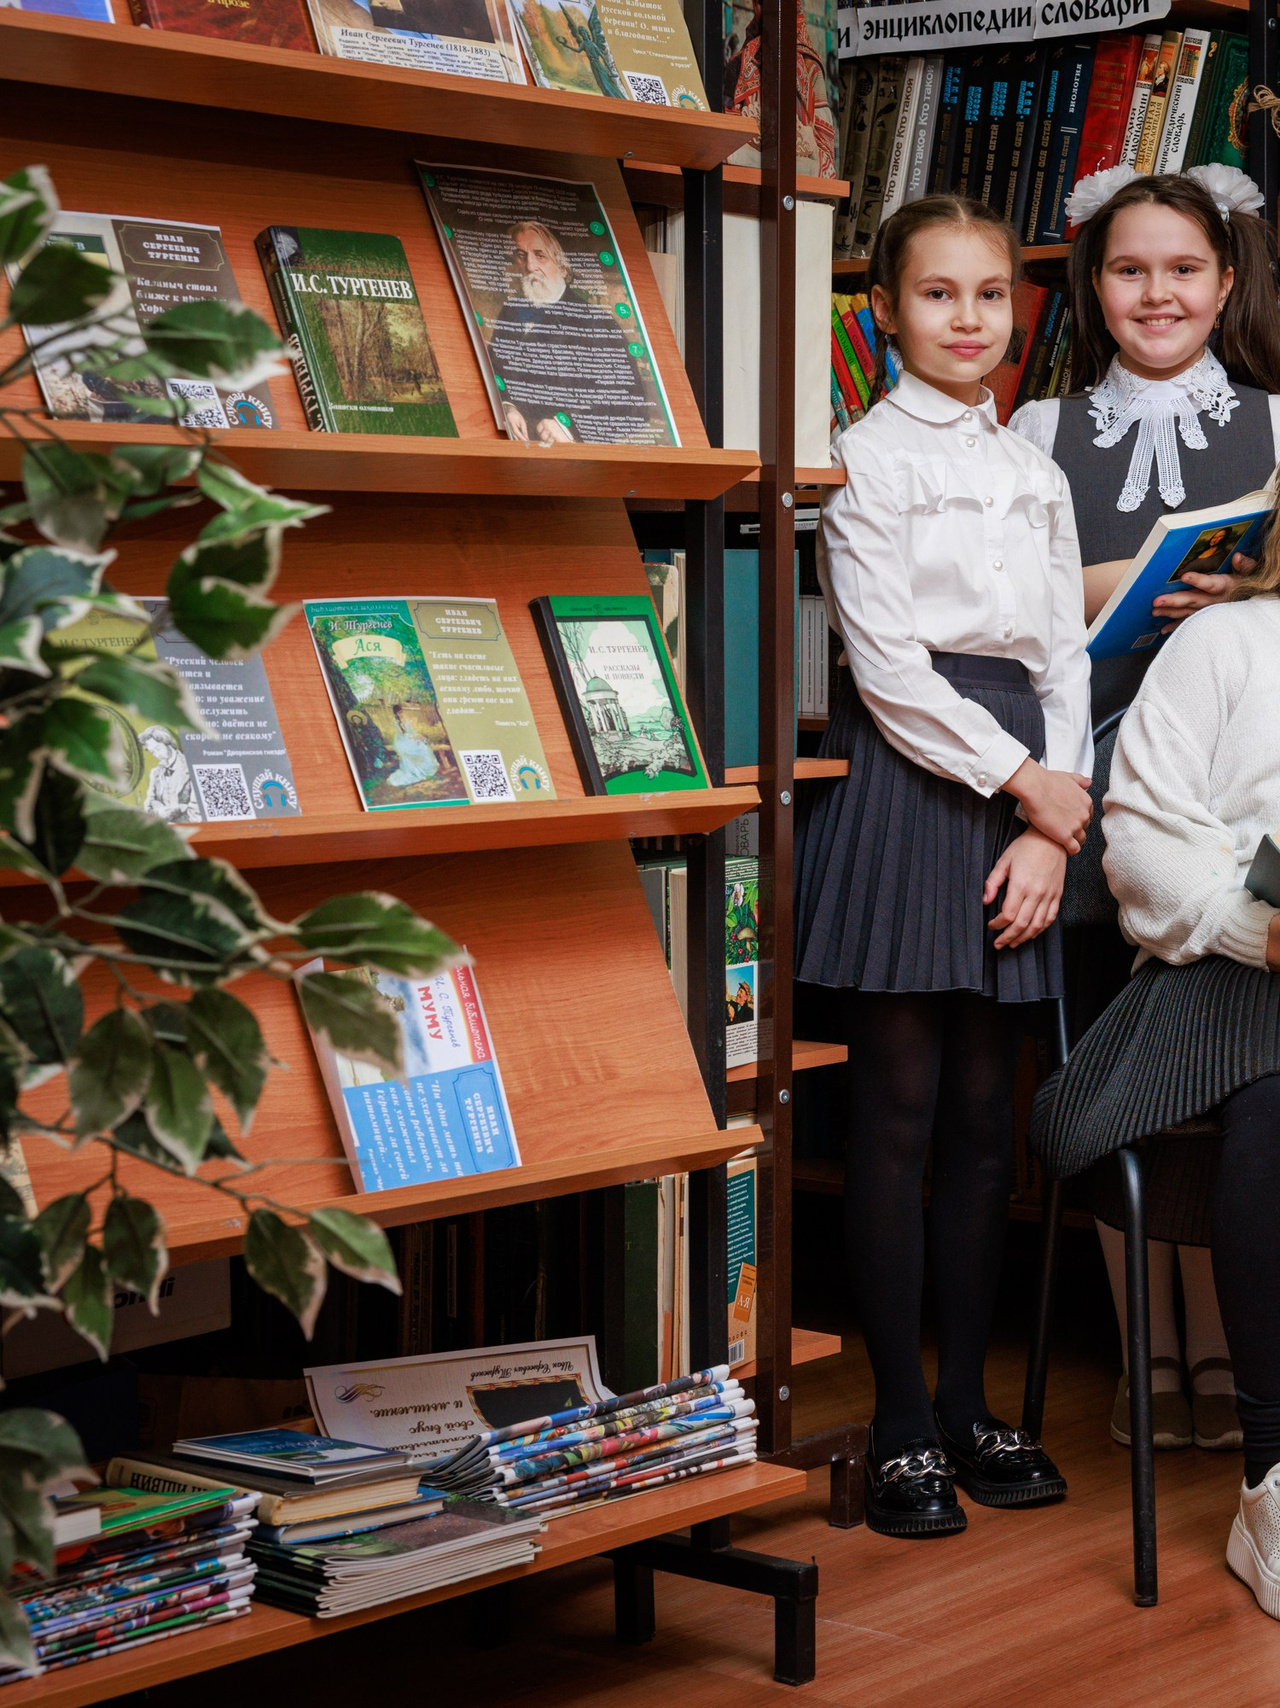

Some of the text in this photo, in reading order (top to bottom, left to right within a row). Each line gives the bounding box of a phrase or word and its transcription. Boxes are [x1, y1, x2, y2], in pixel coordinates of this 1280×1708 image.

[600, 5, 667, 22] русской вольной
[341, 28, 491, 57] Иван Сергеевич Тургенев (1818-1883)
[1069, 63, 1082, 114] БИОЛОГИЯ
[909, 64, 935, 192] Что такое Кто такой
[1137, 101, 1157, 164] ШКОЛЬНАЯ
[1144, 102, 1163, 166] ЭНЦИКЛОПЕДИЯ
[1172, 112, 1186, 153] СЛОВАРЬ
[884, 78, 914, 203] Что такое Кто такой
[1027, 171, 1044, 243] ЭНЦИКЛОПЕДИЯ
[154, 233, 184, 243] ИВАН
[142, 241, 201, 255] СЕРГЕЕВИЧ
[147, 251, 200, 264] ТУРГЕНЕВ
[186, 281, 218, 293] стоял
[290, 272, 414, 300] И.С. ТУРГЕНЕВ
[225, 388, 273, 430] Слушай книгу
[435, 617, 482, 627] СЕРГЕЕВИЧ
[444, 609, 468, 617] ИВАН
[344, 619, 394, 637] Тургенев
[440, 626, 483, 635] ТУРГЕНЕВ
[353, 637, 382, 656] Ася
[606, 645, 649, 654] ТУРГЕНЕВ
[165, 656, 206, 667] "Русский
[465, 652, 486, 660] свете
[459, 663, 505, 671] счастливые
[603, 664, 642, 672] РАССКАЗЫ
[459, 674, 490, 682] глядеть
[440, 685, 471, 695] всякому
[207, 695, 265, 705] но уважение
[459, 696, 484, 706] греют
[200, 707, 249, 717] аслужить
[222, 717, 268, 729] даётся не
[222, 730, 277, 742] не всякому"
[202, 749, 223, 757] Роман
[251, 769, 298, 810] Слушай книгу
[417, 985, 444, 1041] МУМУ
[442, 1005, 461, 1049] Тургенев
[388, 1086, 417, 1164] как ухаживал
[415, 1081, 449, 1173] не ухаживает за
[464, 1097, 484, 1154] ТУРГЕНЕВ
[473, 1091, 495, 1154] СЕРГЕЕВИЧ
[486, 1105, 500, 1136] ИВАН
[376, 1089, 410, 1181] Герасим за своей
[435, 1101, 448, 1128] одна
[443, 1128, 459, 1159] мать
[469, 1359, 574, 1381] Иван Сергеевич Тургенев
[408, 1419, 474, 1436] свой вкус
